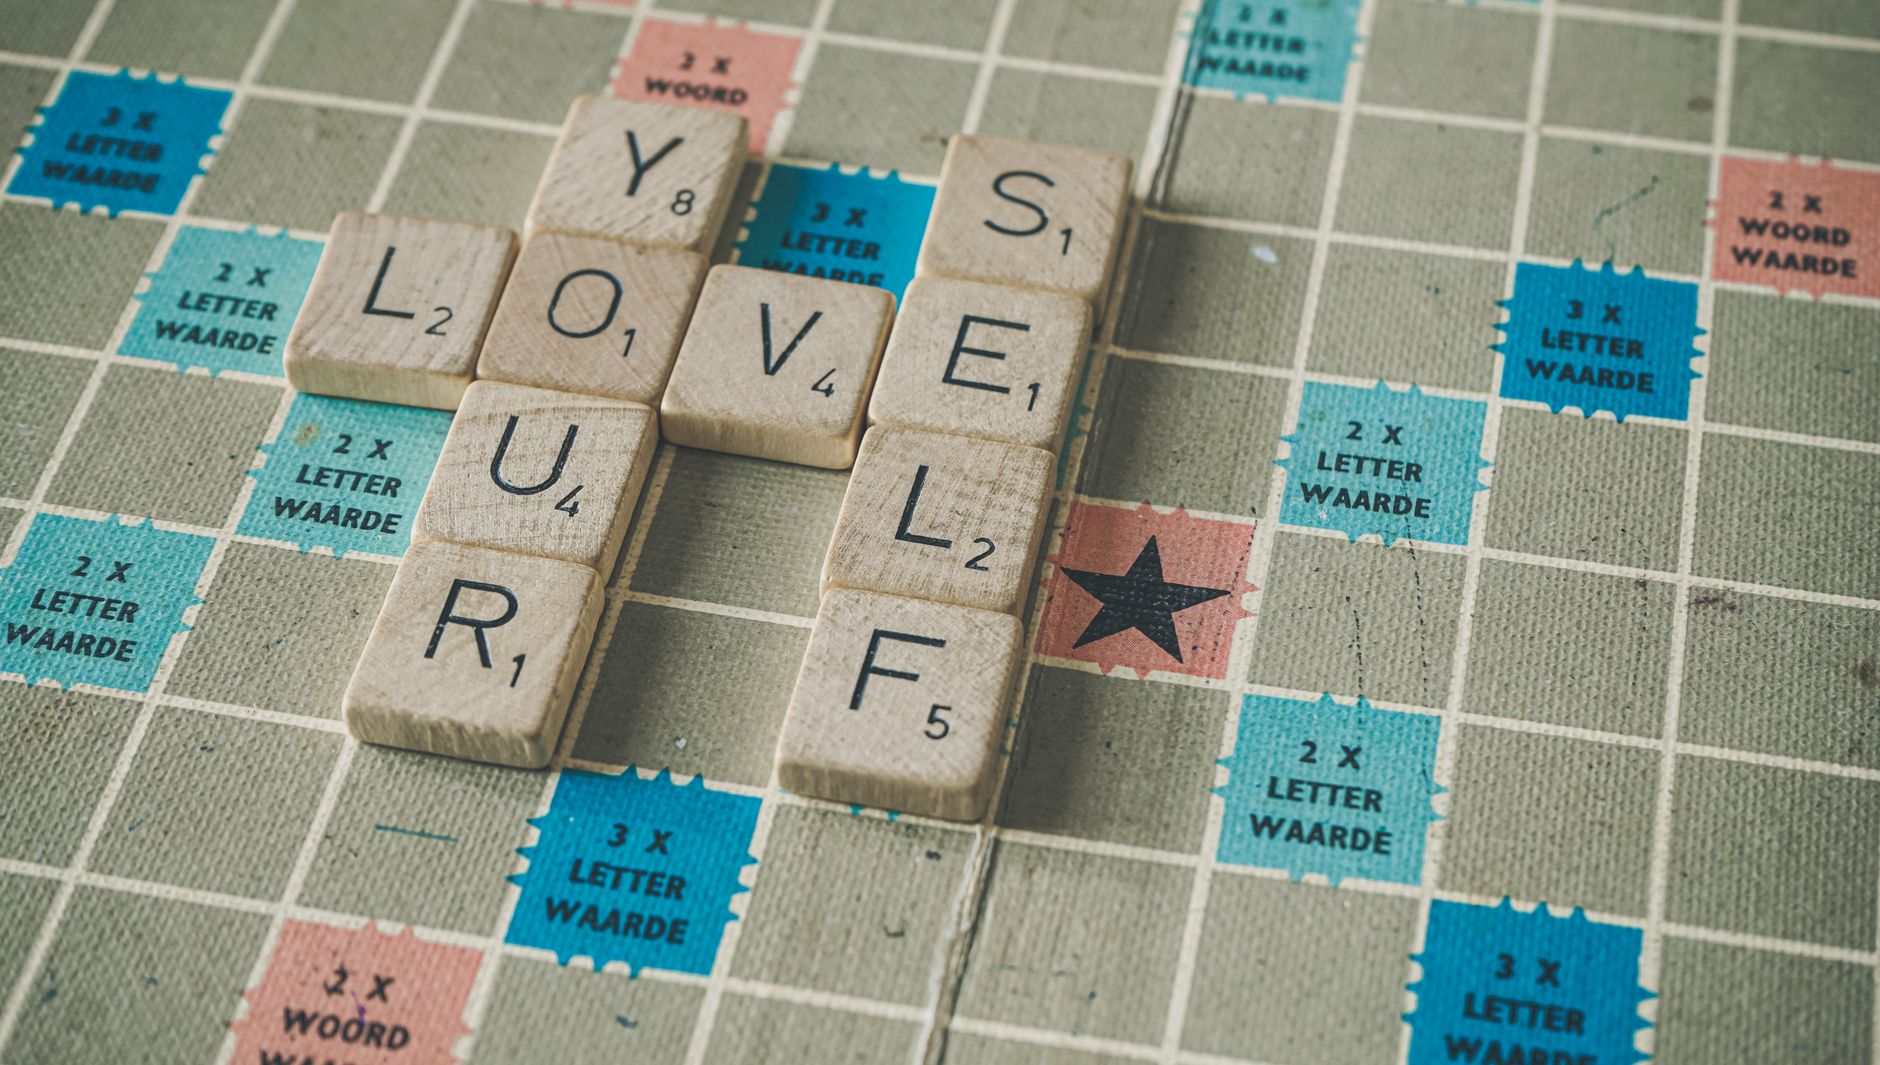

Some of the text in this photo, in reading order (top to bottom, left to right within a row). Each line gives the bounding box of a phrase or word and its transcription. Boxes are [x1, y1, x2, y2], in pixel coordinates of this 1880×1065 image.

[644, 76, 748, 105] WOORD
[67, 132, 163, 162] LETTER
[42, 160, 160, 194] WAARDE
[671, 189, 695, 216] 8
[810, 202, 867, 228] 3 X
[1803, 194, 1822, 213] X
[781, 230, 880, 261] LETTER
[1059, 227, 1073, 255] 1
[1738, 216, 1850, 247] WOORD
[213, 263, 271, 286] 2 X
[1731, 245, 1857, 279] WAARDE
[178, 291, 278, 322] LETTER
[425, 307, 453, 336] 2
[1567, 301, 1622, 325] 3 X
[155, 320, 277, 355] WAARDE
[621, 328, 636, 358] 1
[1540, 328, 1644, 360] LETTER
[811, 368, 836, 398] 4
[1525, 358, 1655, 395] WAARDE
[1028, 382, 1040, 411] 1
[333, 434, 394, 460] 2 X
[1347, 421, 1404, 446] 2 X
[295, 464, 402, 498] LETTER
[1316, 450, 1423, 484] LETTER
[274, 497, 402, 535] WAARDE
[555, 485, 584, 517] 4
[1300, 482, 1431, 519] WAARDE
[70, 556, 133, 583] 2 X
[965, 538, 996, 571] 2
[30, 588, 139, 623] LETTER
[7, 623, 137, 662] WAARDE
[509, 653, 525, 689] 1
[924, 704, 953, 741] 5
[1300, 741, 1362, 770] 2 X
[1267, 776, 1383, 813] LETTER
[607, 822, 673, 854] 3 X
[1250, 814, 1392, 856] WAARDE
[569, 858, 686, 901] LETTER
[545, 896, 689, 946] WAARDE
[1494, 953, 1561, 988] 3 X
[366, 974, 395, 1002] X
[283, 1006, 410, 1050] WOORD
[1463, 992, 1585, 1036] LETTER
